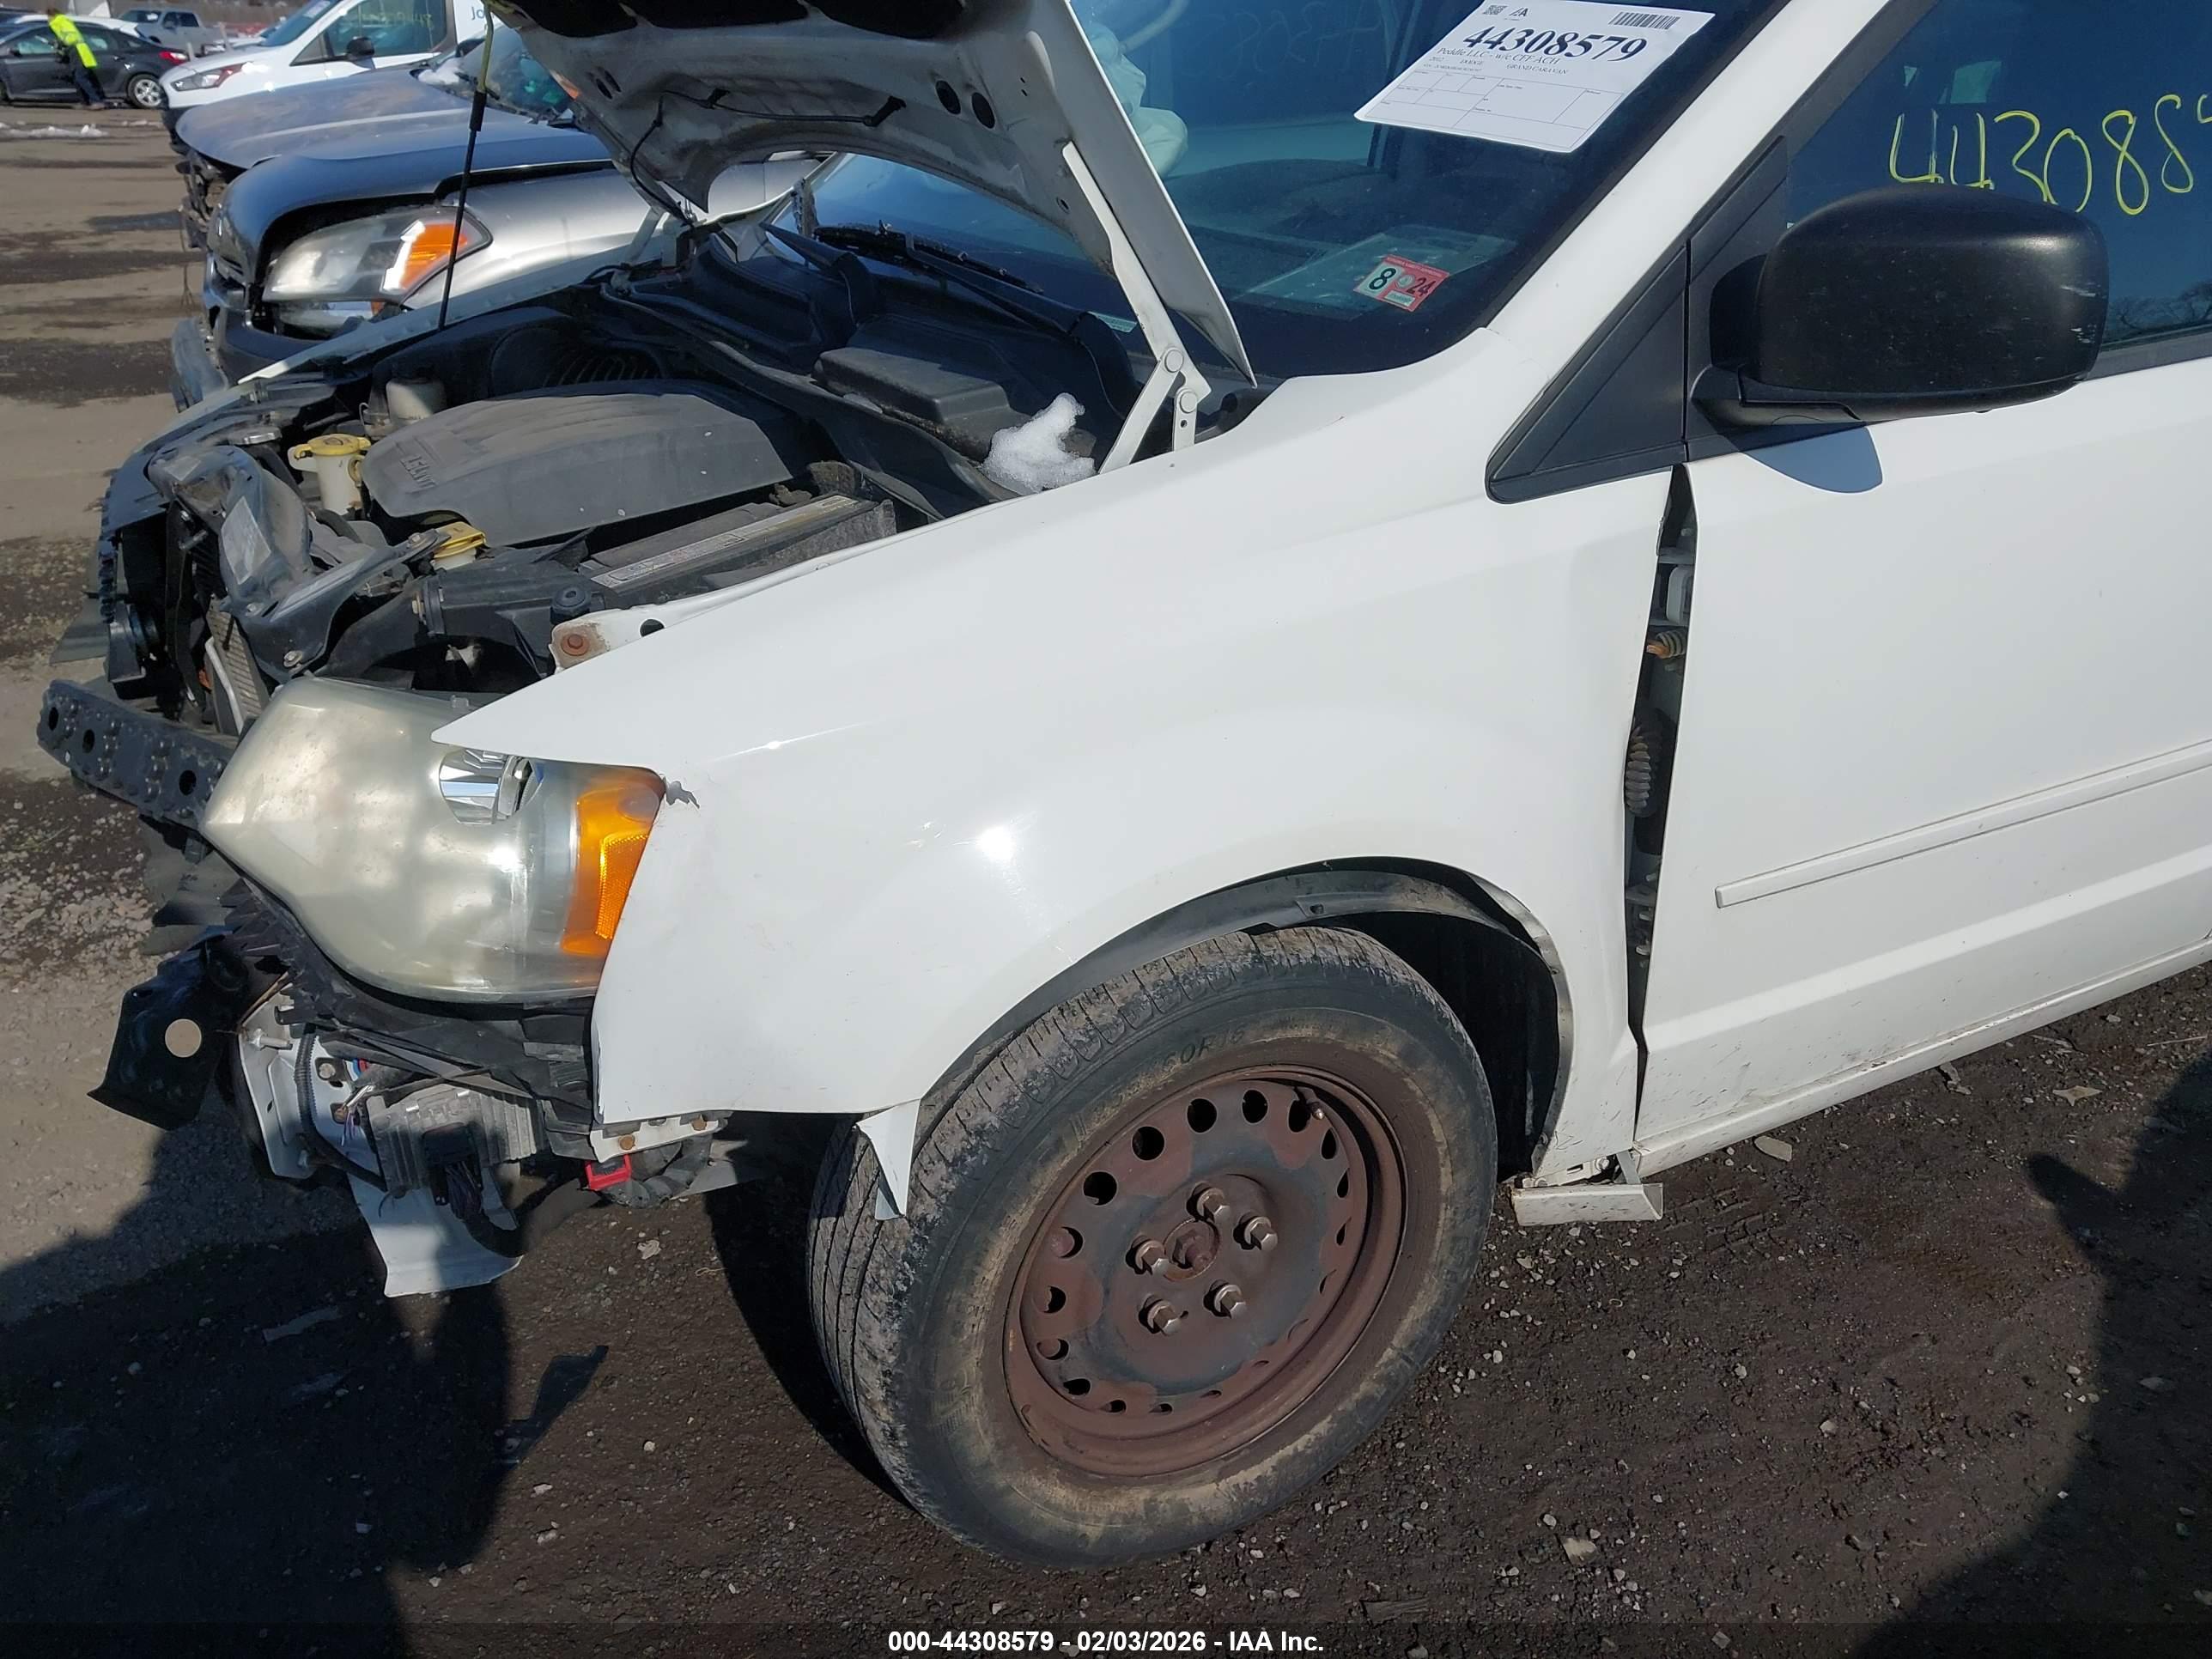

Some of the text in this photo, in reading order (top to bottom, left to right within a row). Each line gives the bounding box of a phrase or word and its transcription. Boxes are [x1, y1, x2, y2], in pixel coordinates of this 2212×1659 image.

[1437, 47, 1466, 56] Peddle
[1533, 56, 1561, 65] ACH
[1463, 26, 1648, 62] 44308579
[1369, 267, 1397, 290] 8
[1406, 276, 1437, 297] 24
